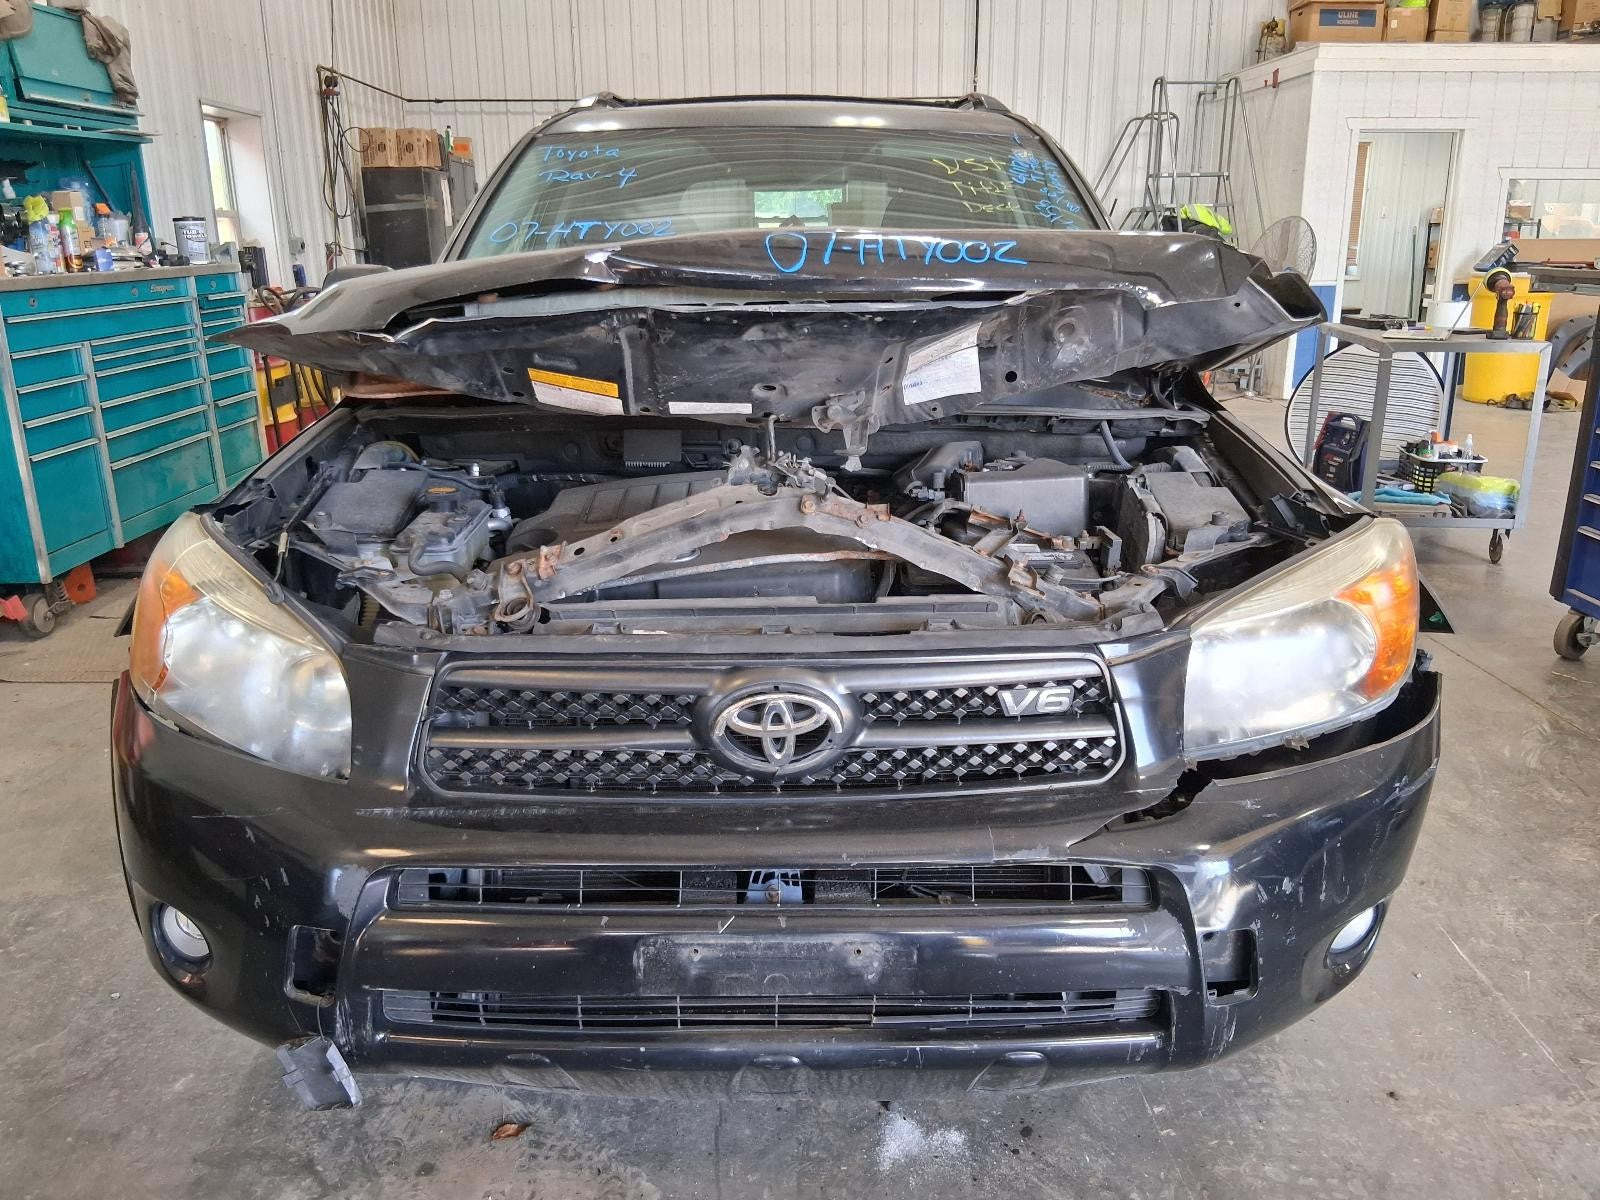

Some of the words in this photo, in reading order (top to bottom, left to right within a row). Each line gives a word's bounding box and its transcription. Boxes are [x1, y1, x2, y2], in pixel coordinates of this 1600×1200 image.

[543, 145, 620, 161] Toyota
[490, 217, 676, 243] 07-HTY002
[1000, 687, 1072, 716] V6
